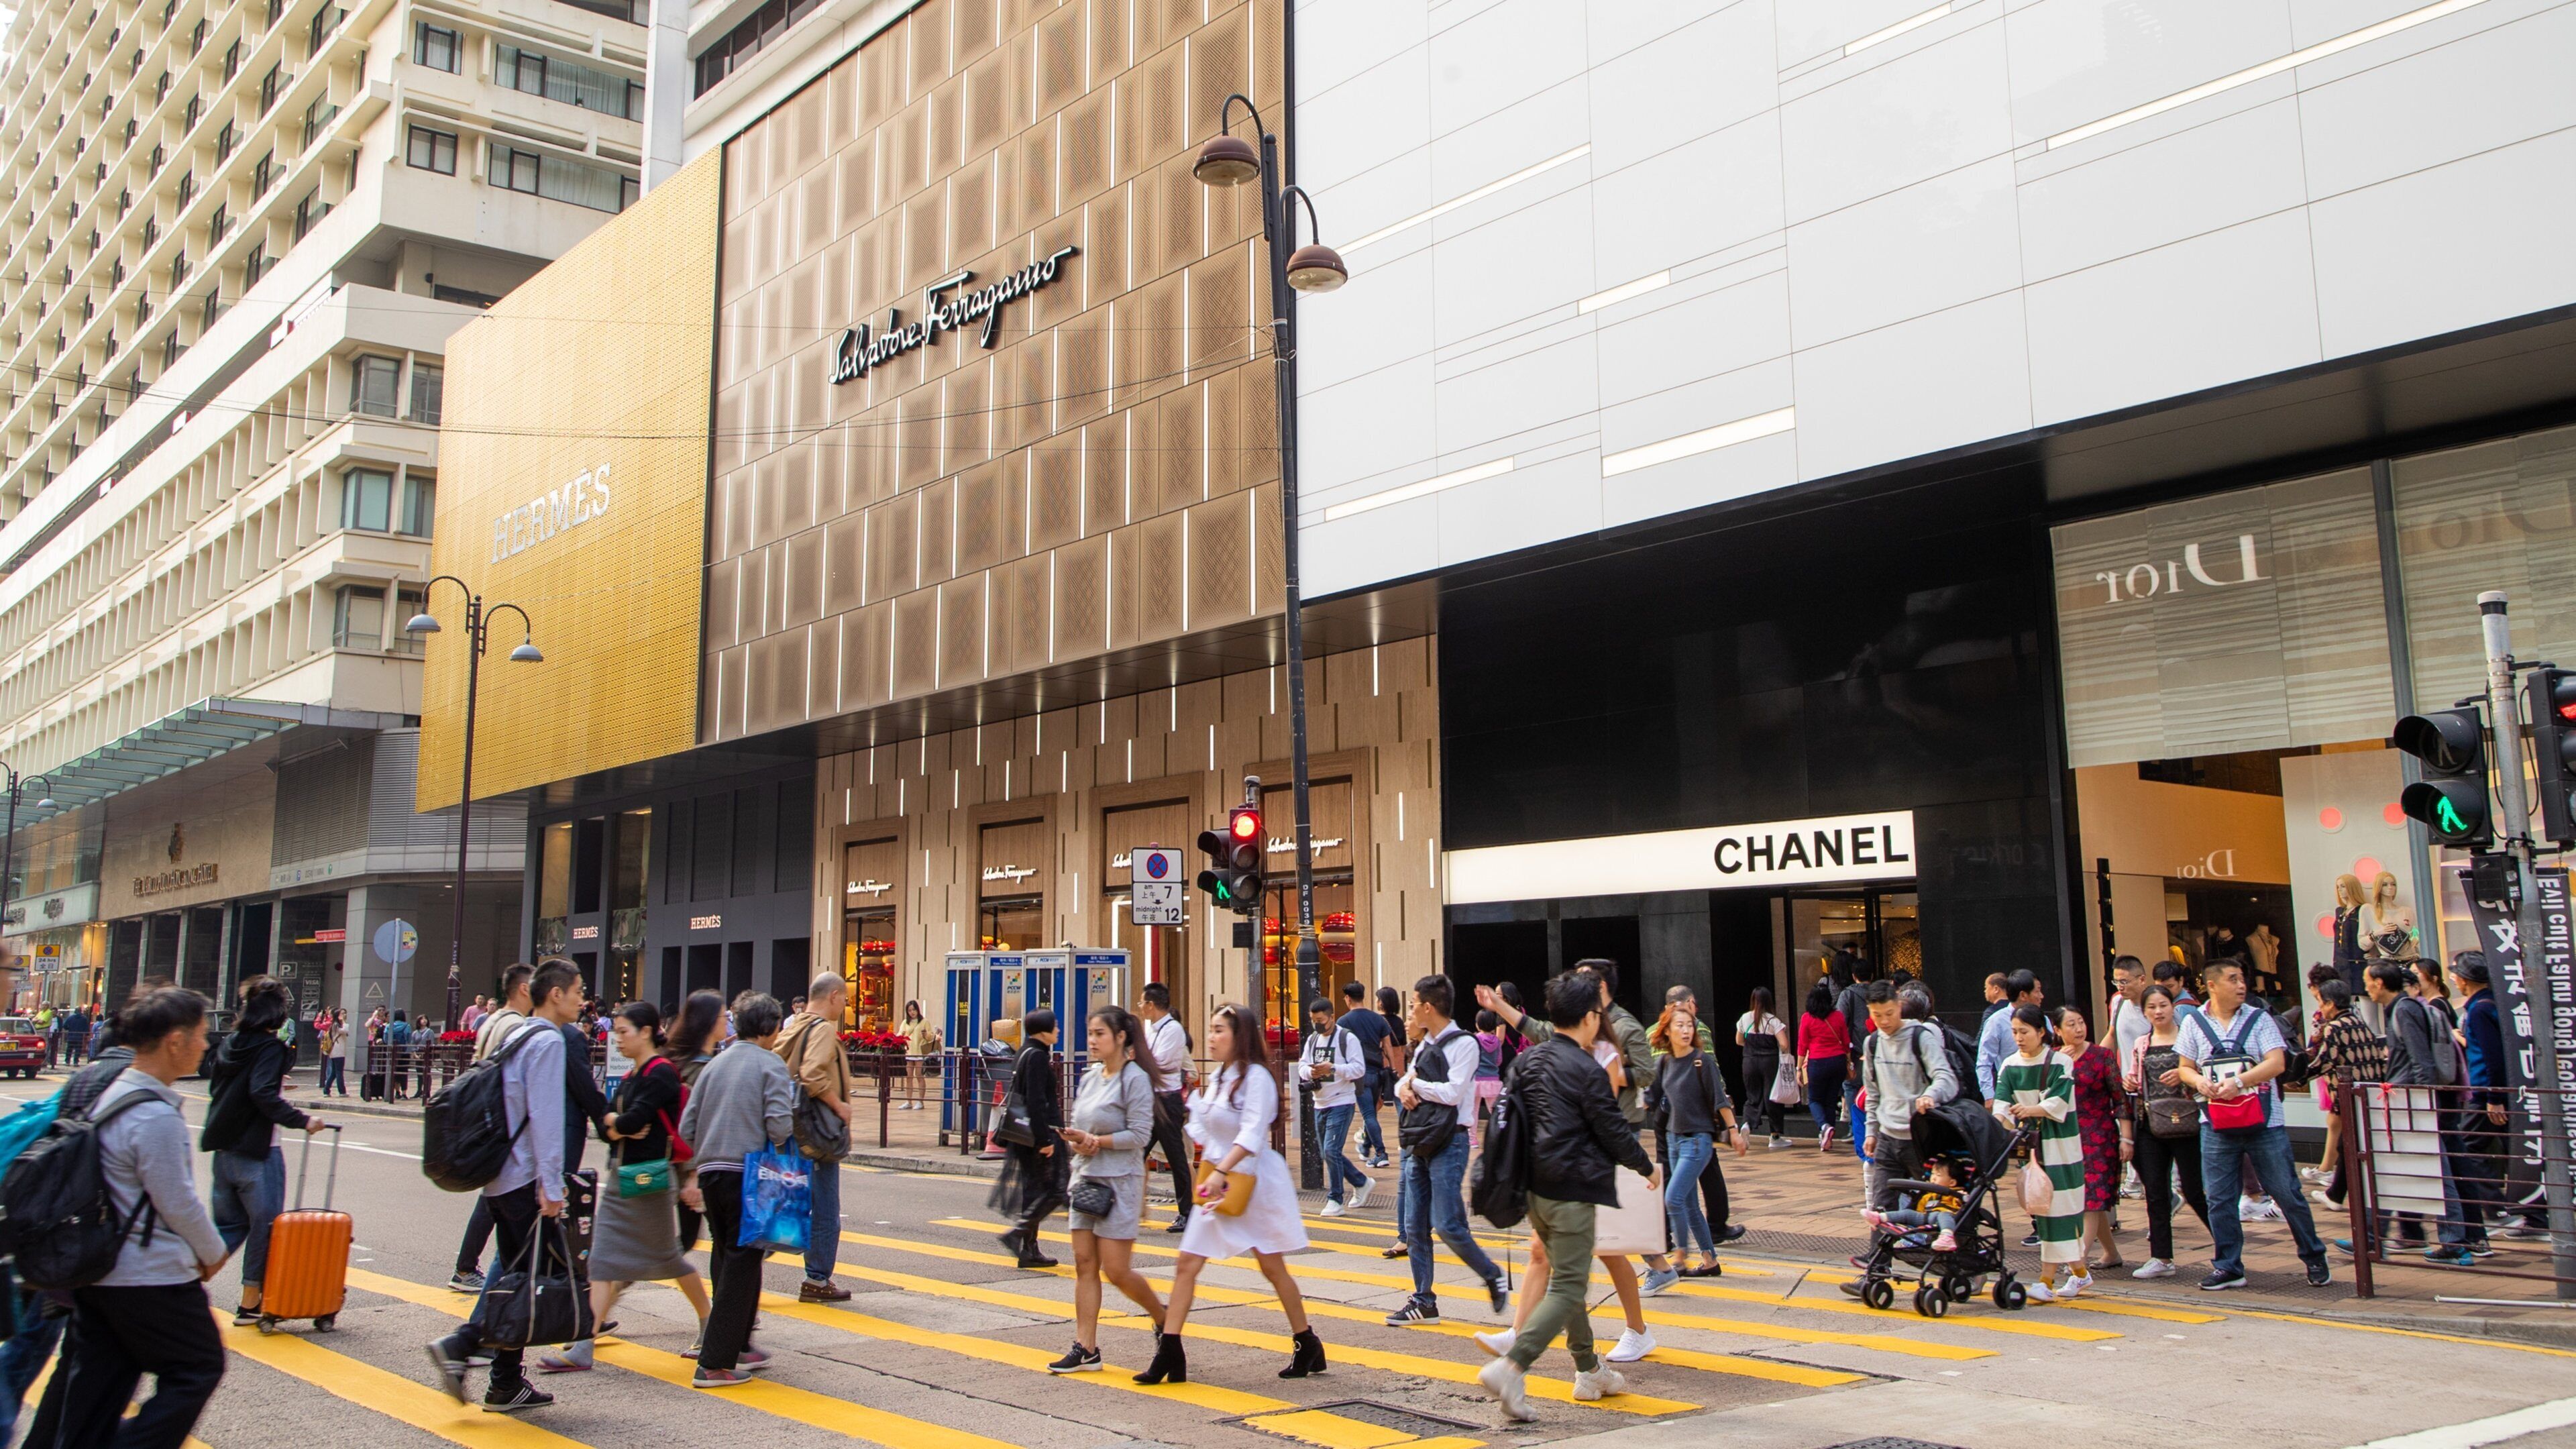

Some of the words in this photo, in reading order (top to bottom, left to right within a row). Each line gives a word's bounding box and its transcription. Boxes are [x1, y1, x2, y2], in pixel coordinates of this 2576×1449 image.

[828, 308, 926, 384] Salvatore
[926, 246, 1079, 349] Ferragamo
[1714, 825, 1909, 874] CHANEL
[1164, 885, 1172, 899] 7
[1303, 884, 1308, 896] DF
[1165, 908, 1179, 921] 12
